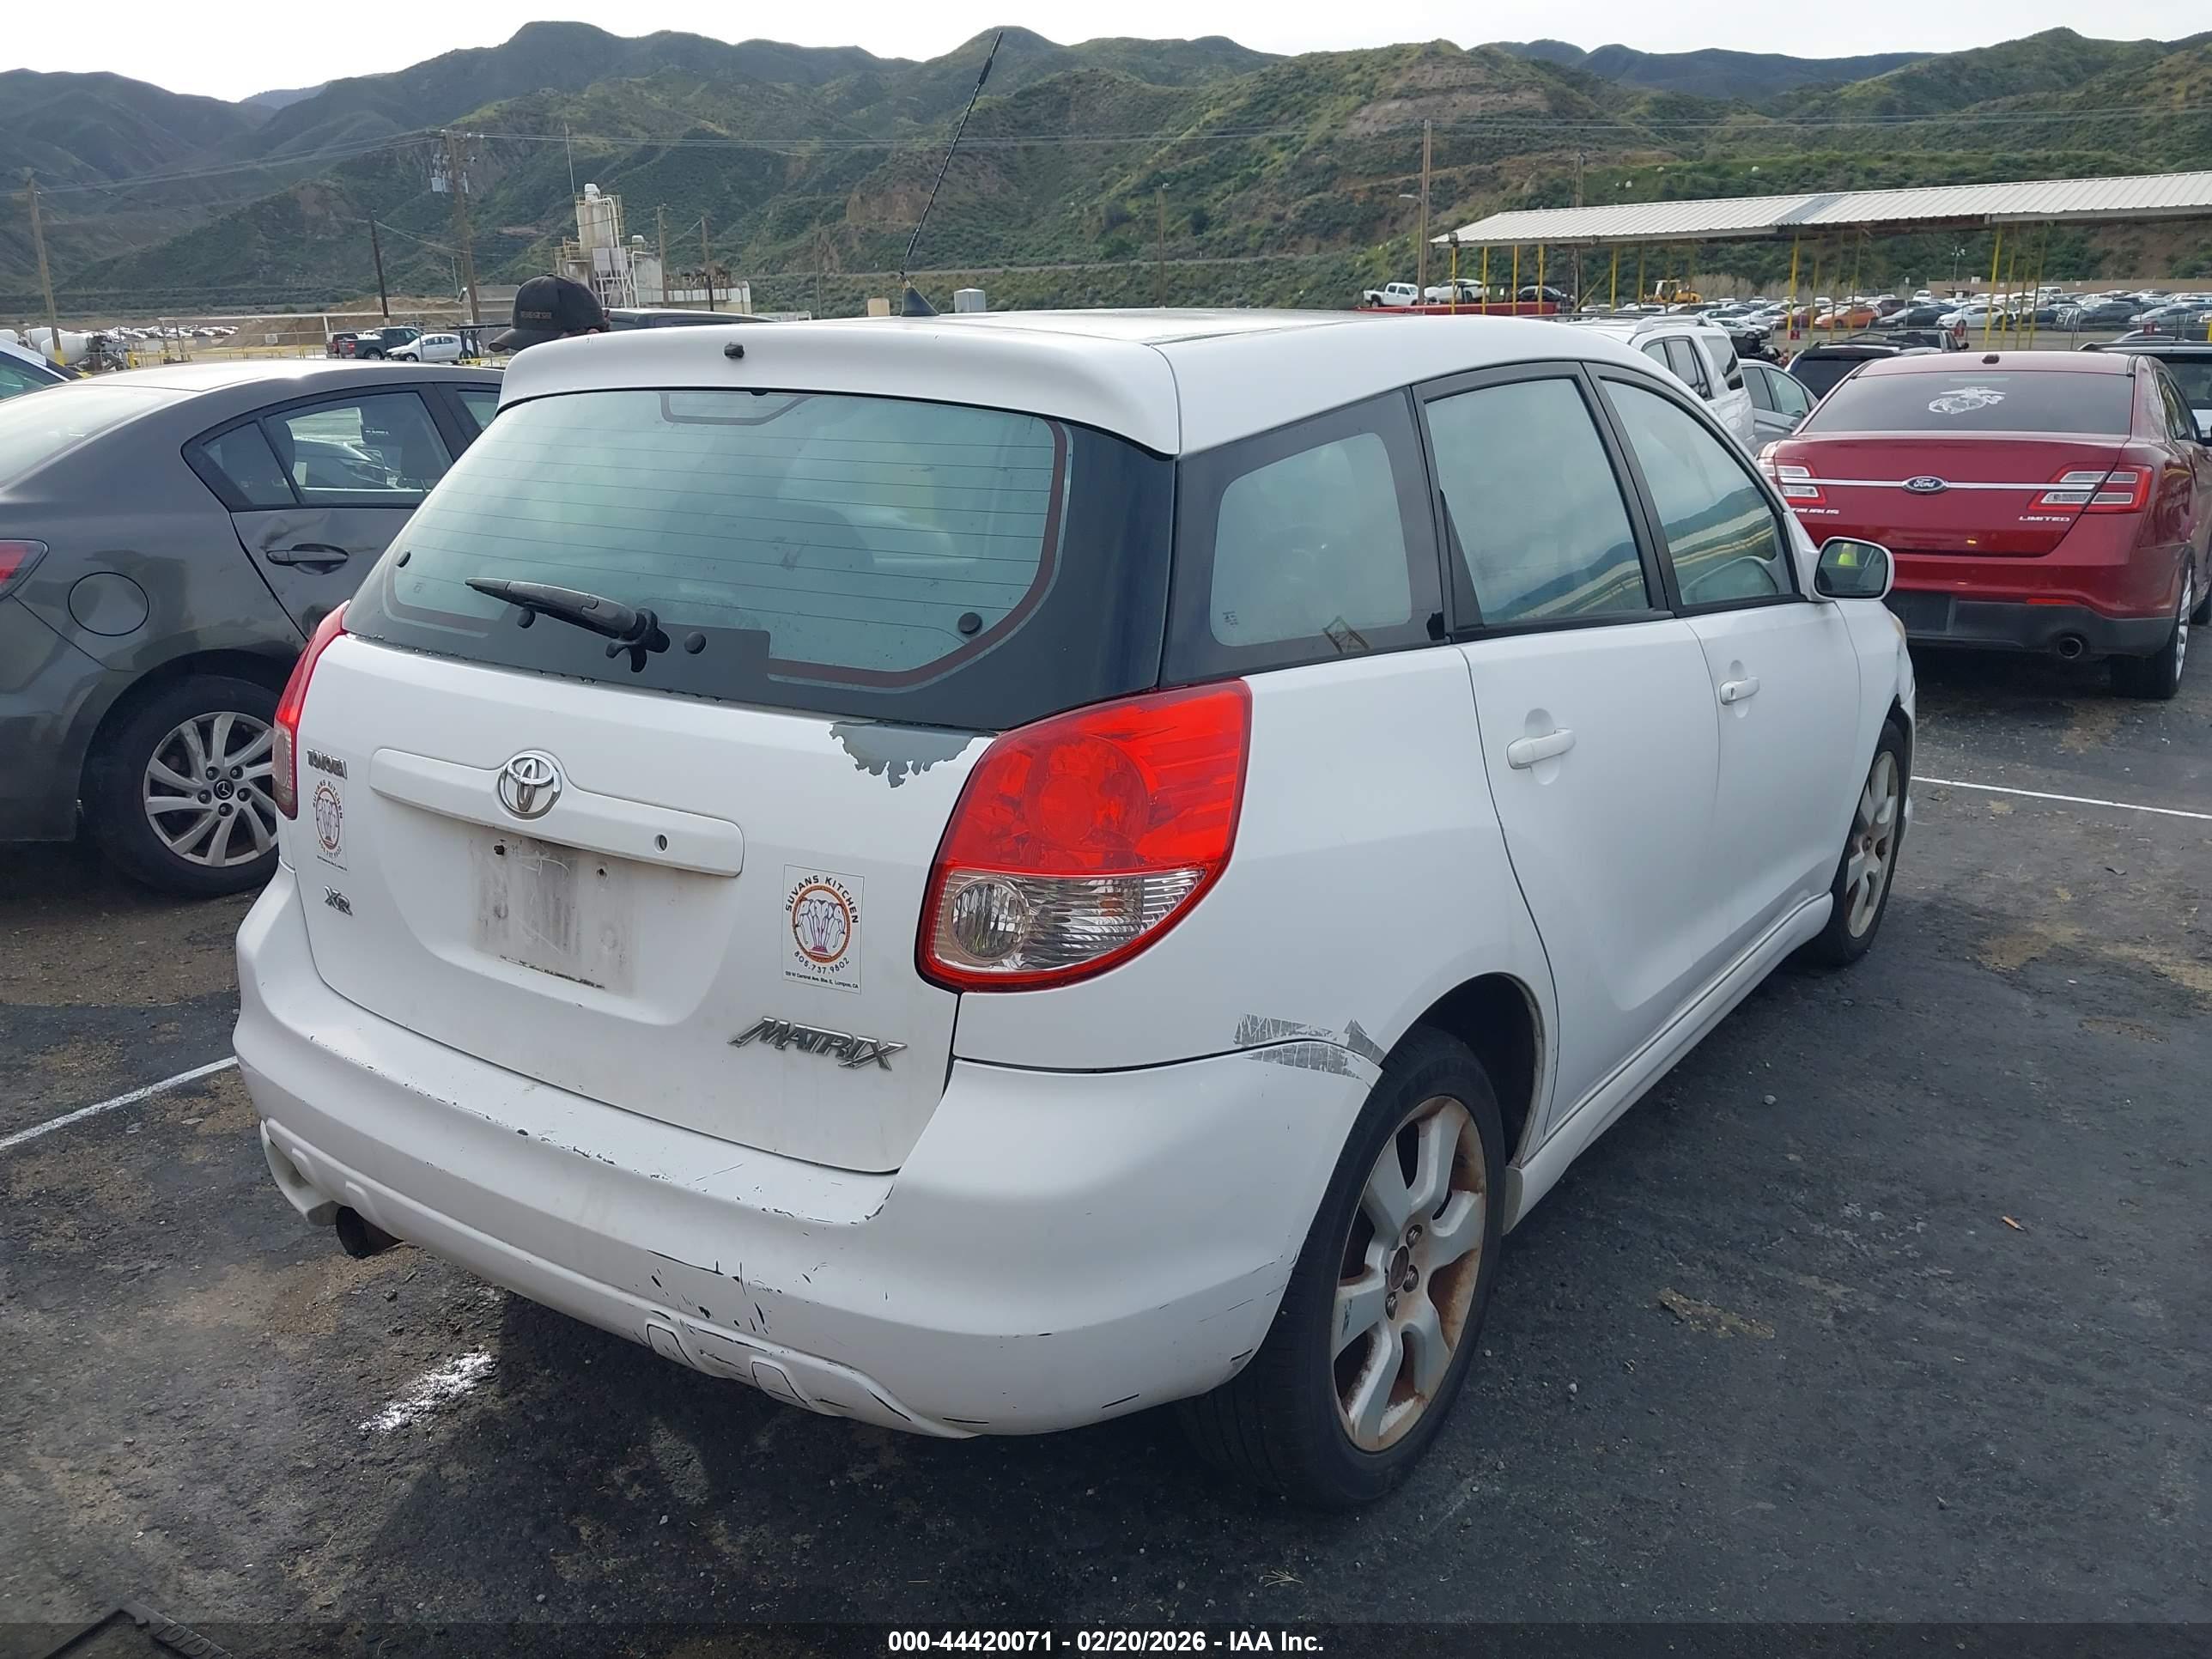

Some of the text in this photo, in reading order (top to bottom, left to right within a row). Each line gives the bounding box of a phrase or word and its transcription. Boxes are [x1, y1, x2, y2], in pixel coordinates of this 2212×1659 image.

[307, 748, 348, 780] TOYOTA
[785, 874, 860, 924] SUVANS KITCHEN
[727, 1016, 908, 1072] MATRIX
